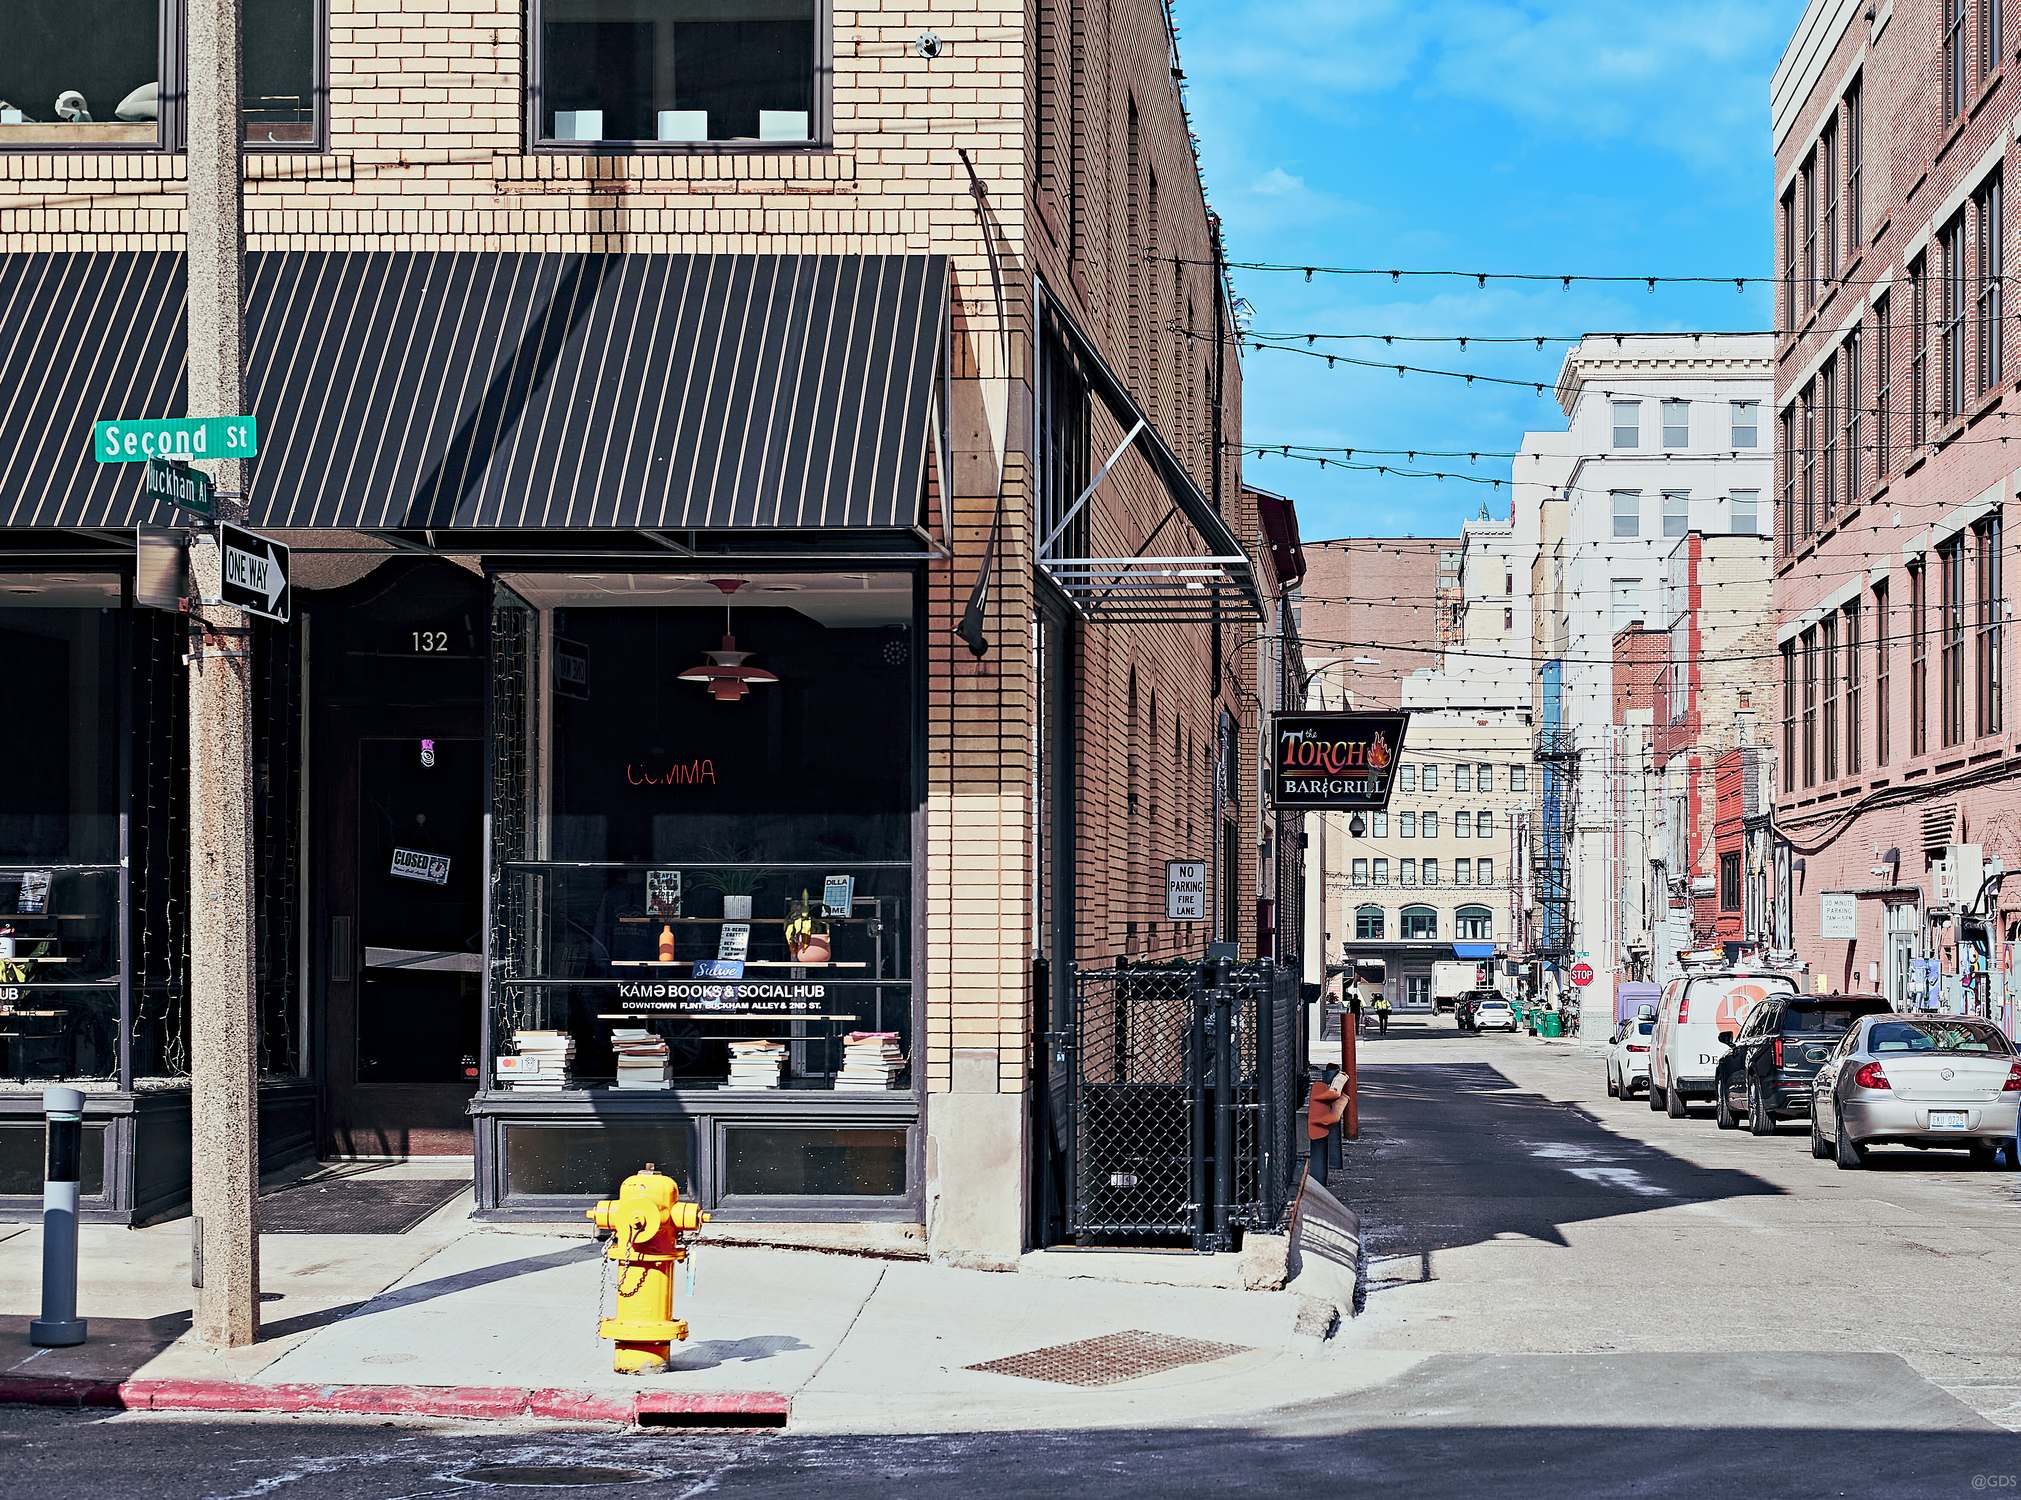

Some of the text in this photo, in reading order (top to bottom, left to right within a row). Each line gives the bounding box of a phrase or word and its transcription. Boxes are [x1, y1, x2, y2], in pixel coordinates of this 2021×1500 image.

[105, 424, 248, 455] Second St
[228, 551, 269, 590] ONE WAY
[412, 631, 448, 652] 132
[1280, 730, 1366, 774] TORCH
[394, 851, 429, 869] CLOSED
[1180, 867, 1194, 877] NO
[1171, 881, 1202, 892] PARKING
[1177, 907, 1195, 915] LANE
[697, 963, 737, 976] Sulwe
[1571, 970, 1593, 979] STOP
[668, 985, 722, 998] BOOKS
[724, 985, 735, 998] &
